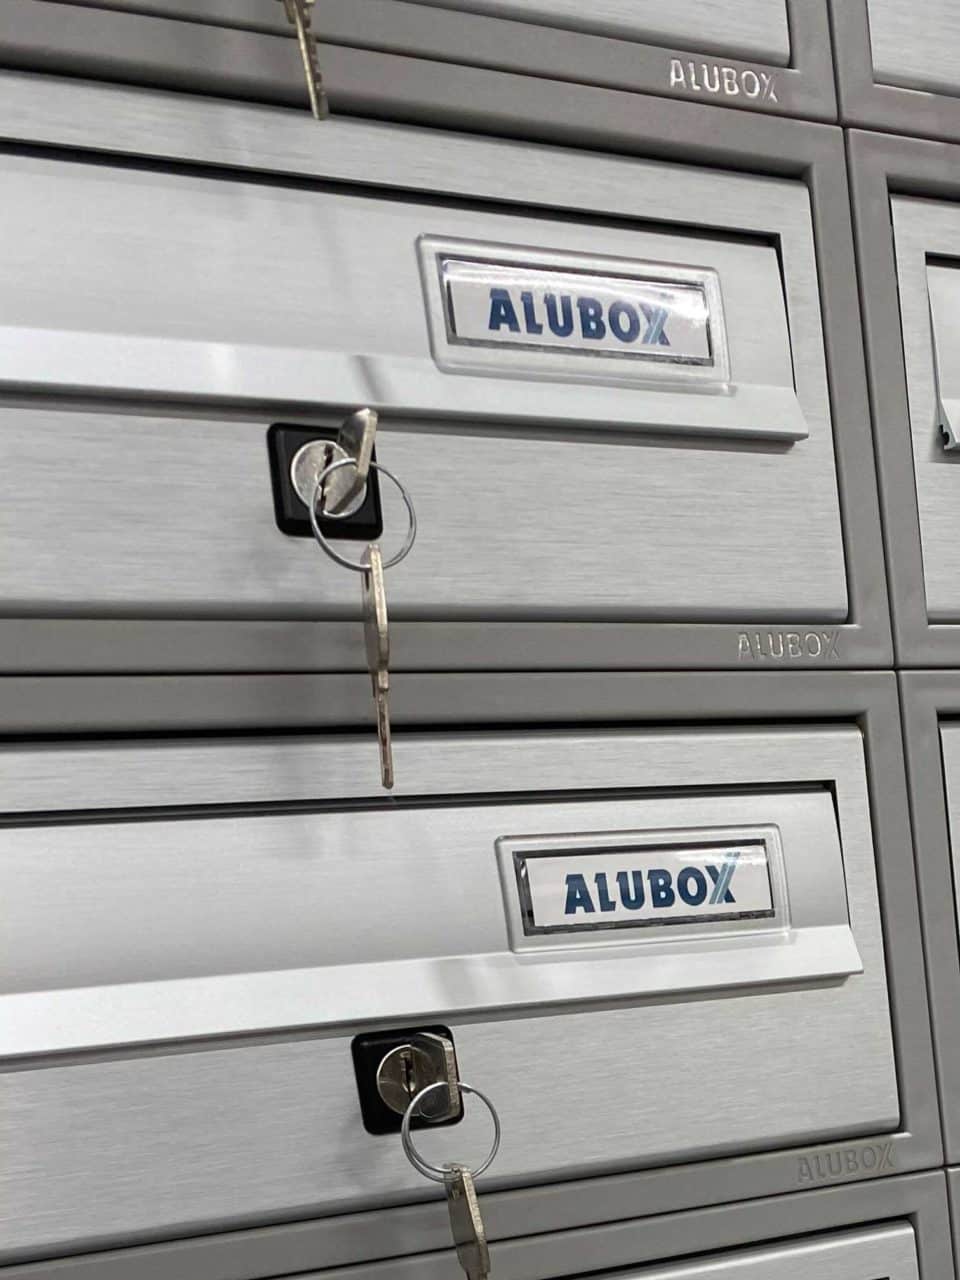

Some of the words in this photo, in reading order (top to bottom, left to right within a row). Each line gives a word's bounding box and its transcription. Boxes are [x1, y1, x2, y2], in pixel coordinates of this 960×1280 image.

[670, 61, 778, 102] ALUBOX
[488, 287, 670, 346] ALUBOX
[738, 631, 839, 658] ALUBOX
[564, 852, 741, 914] ALUBOX
[797, 1144, 895, 1183] ALUBOX
